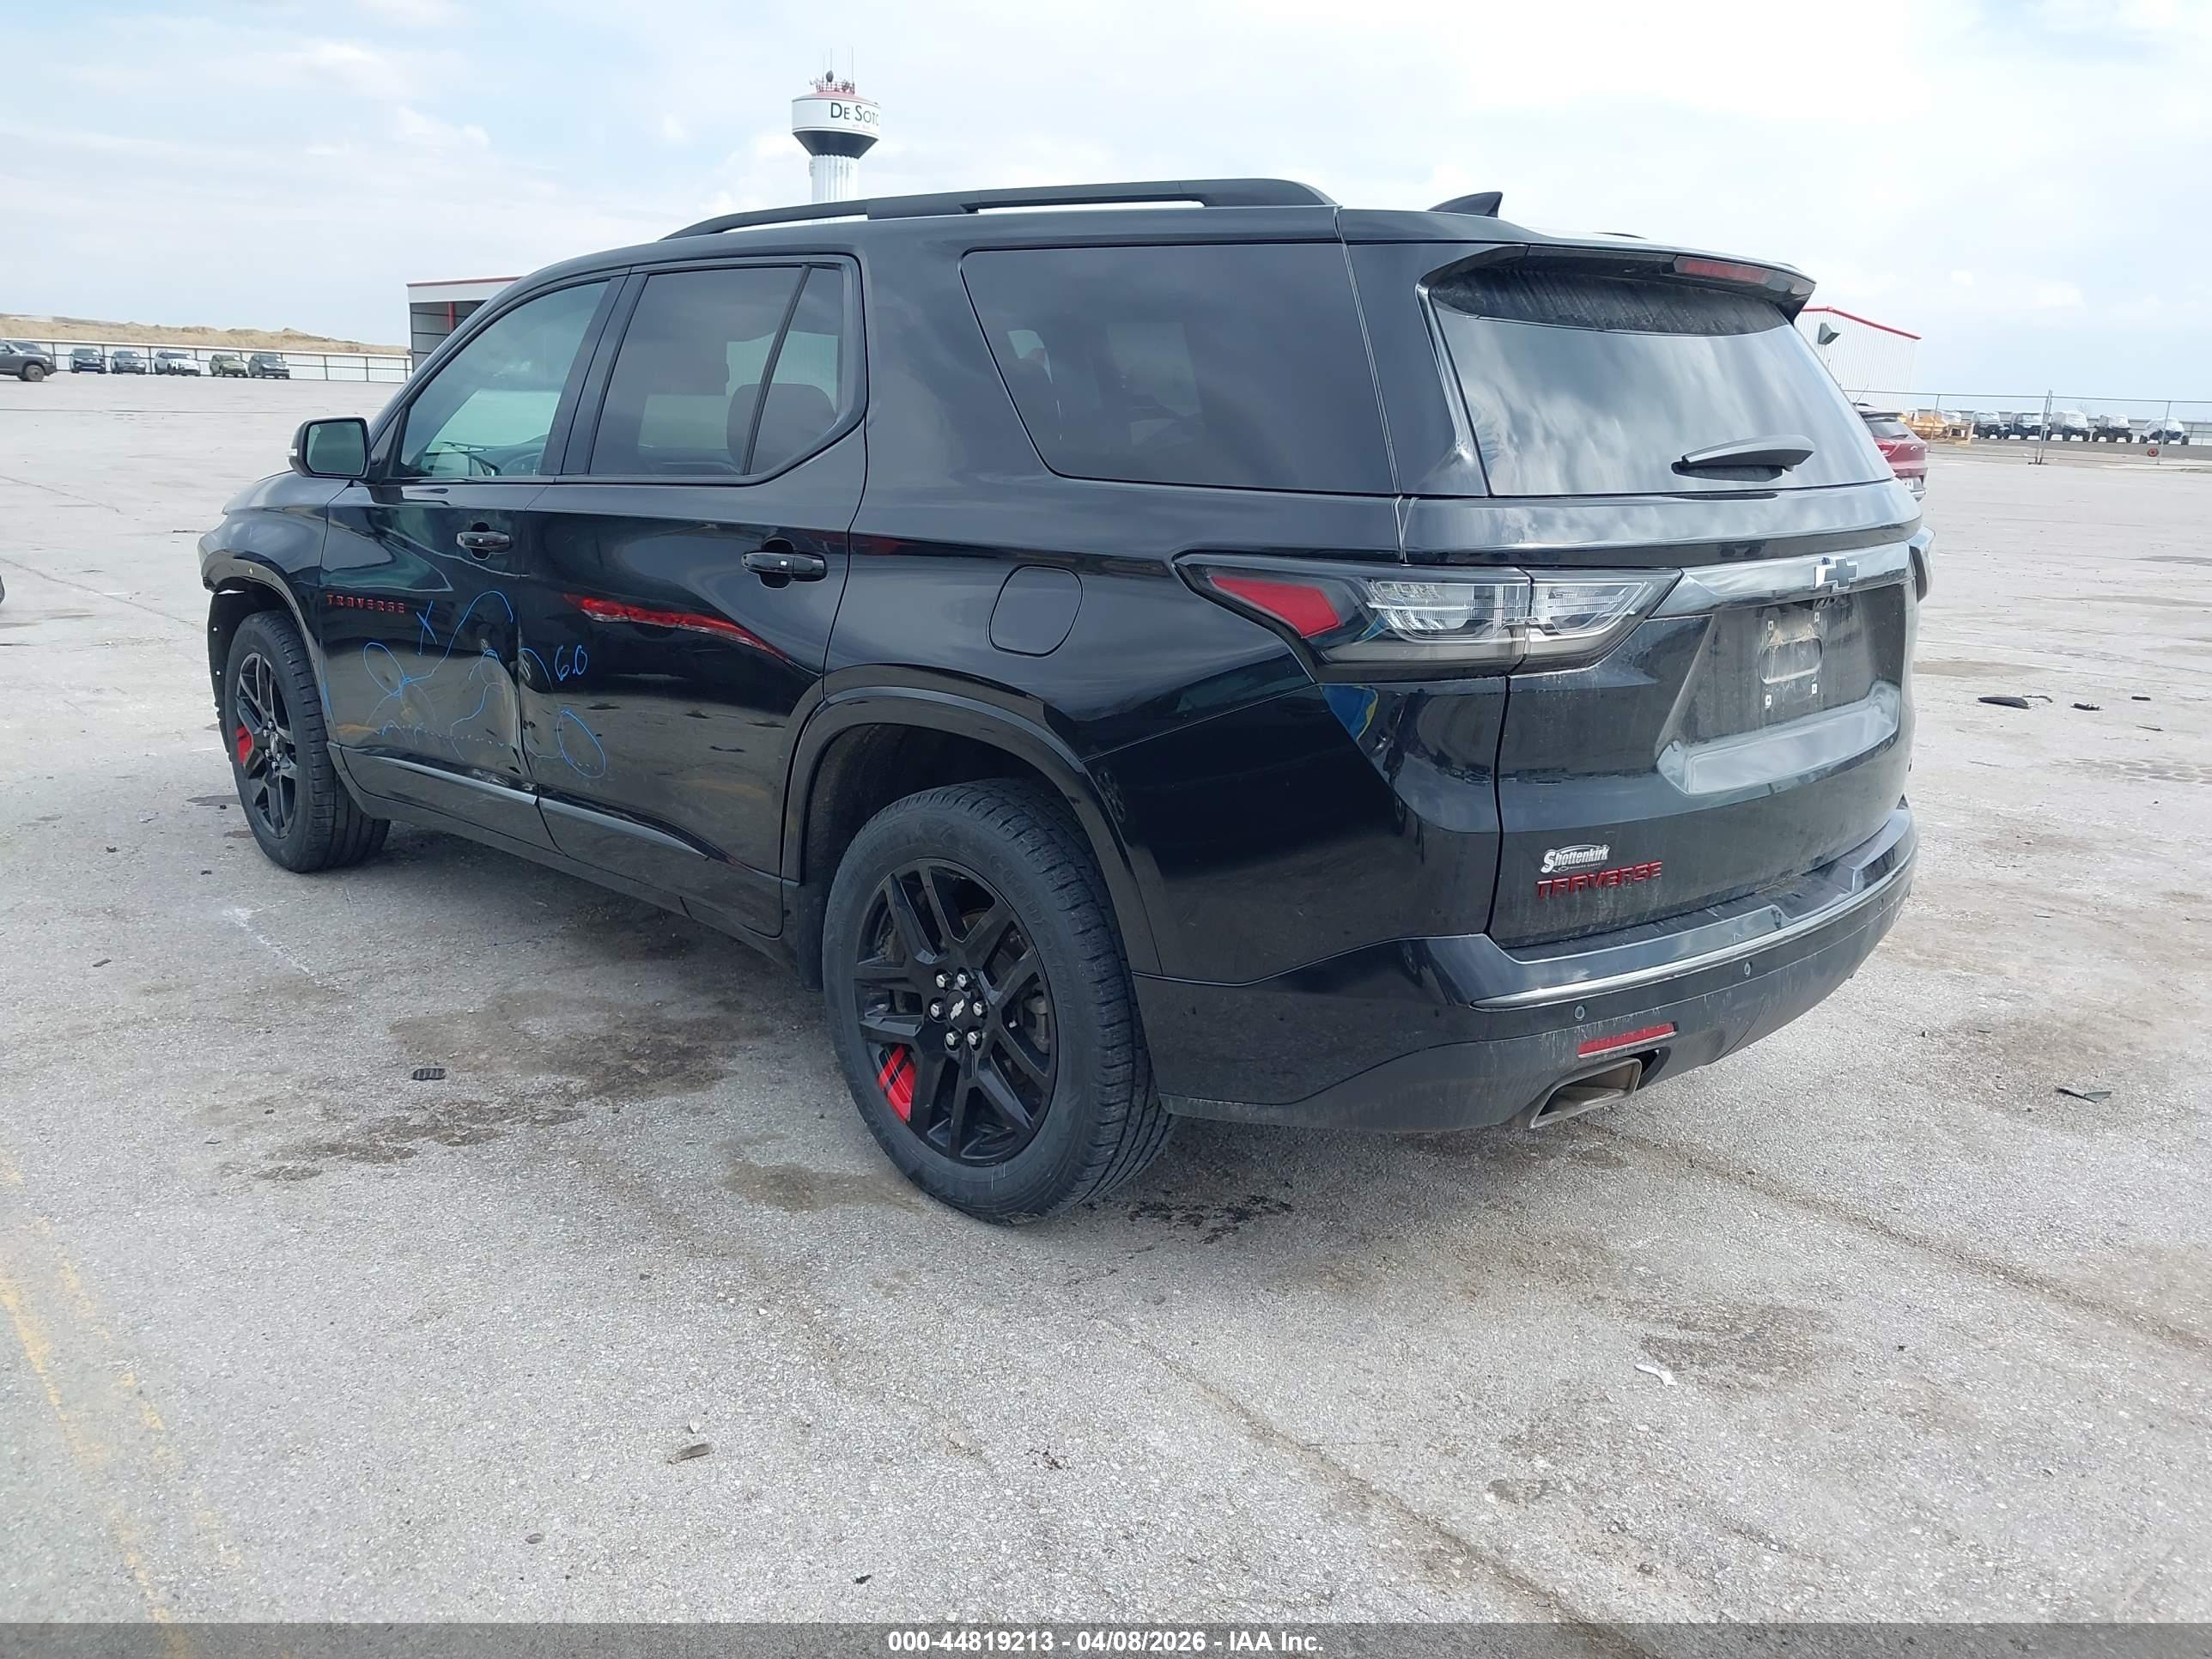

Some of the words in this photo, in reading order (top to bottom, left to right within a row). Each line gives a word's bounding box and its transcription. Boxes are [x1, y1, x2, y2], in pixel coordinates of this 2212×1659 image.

[325, 592, 405, 614] TRAVERSE
[1540, 846, 1610, 873] Shottenkirk
[1536, 860, 1663, 900] TRAVERSE
